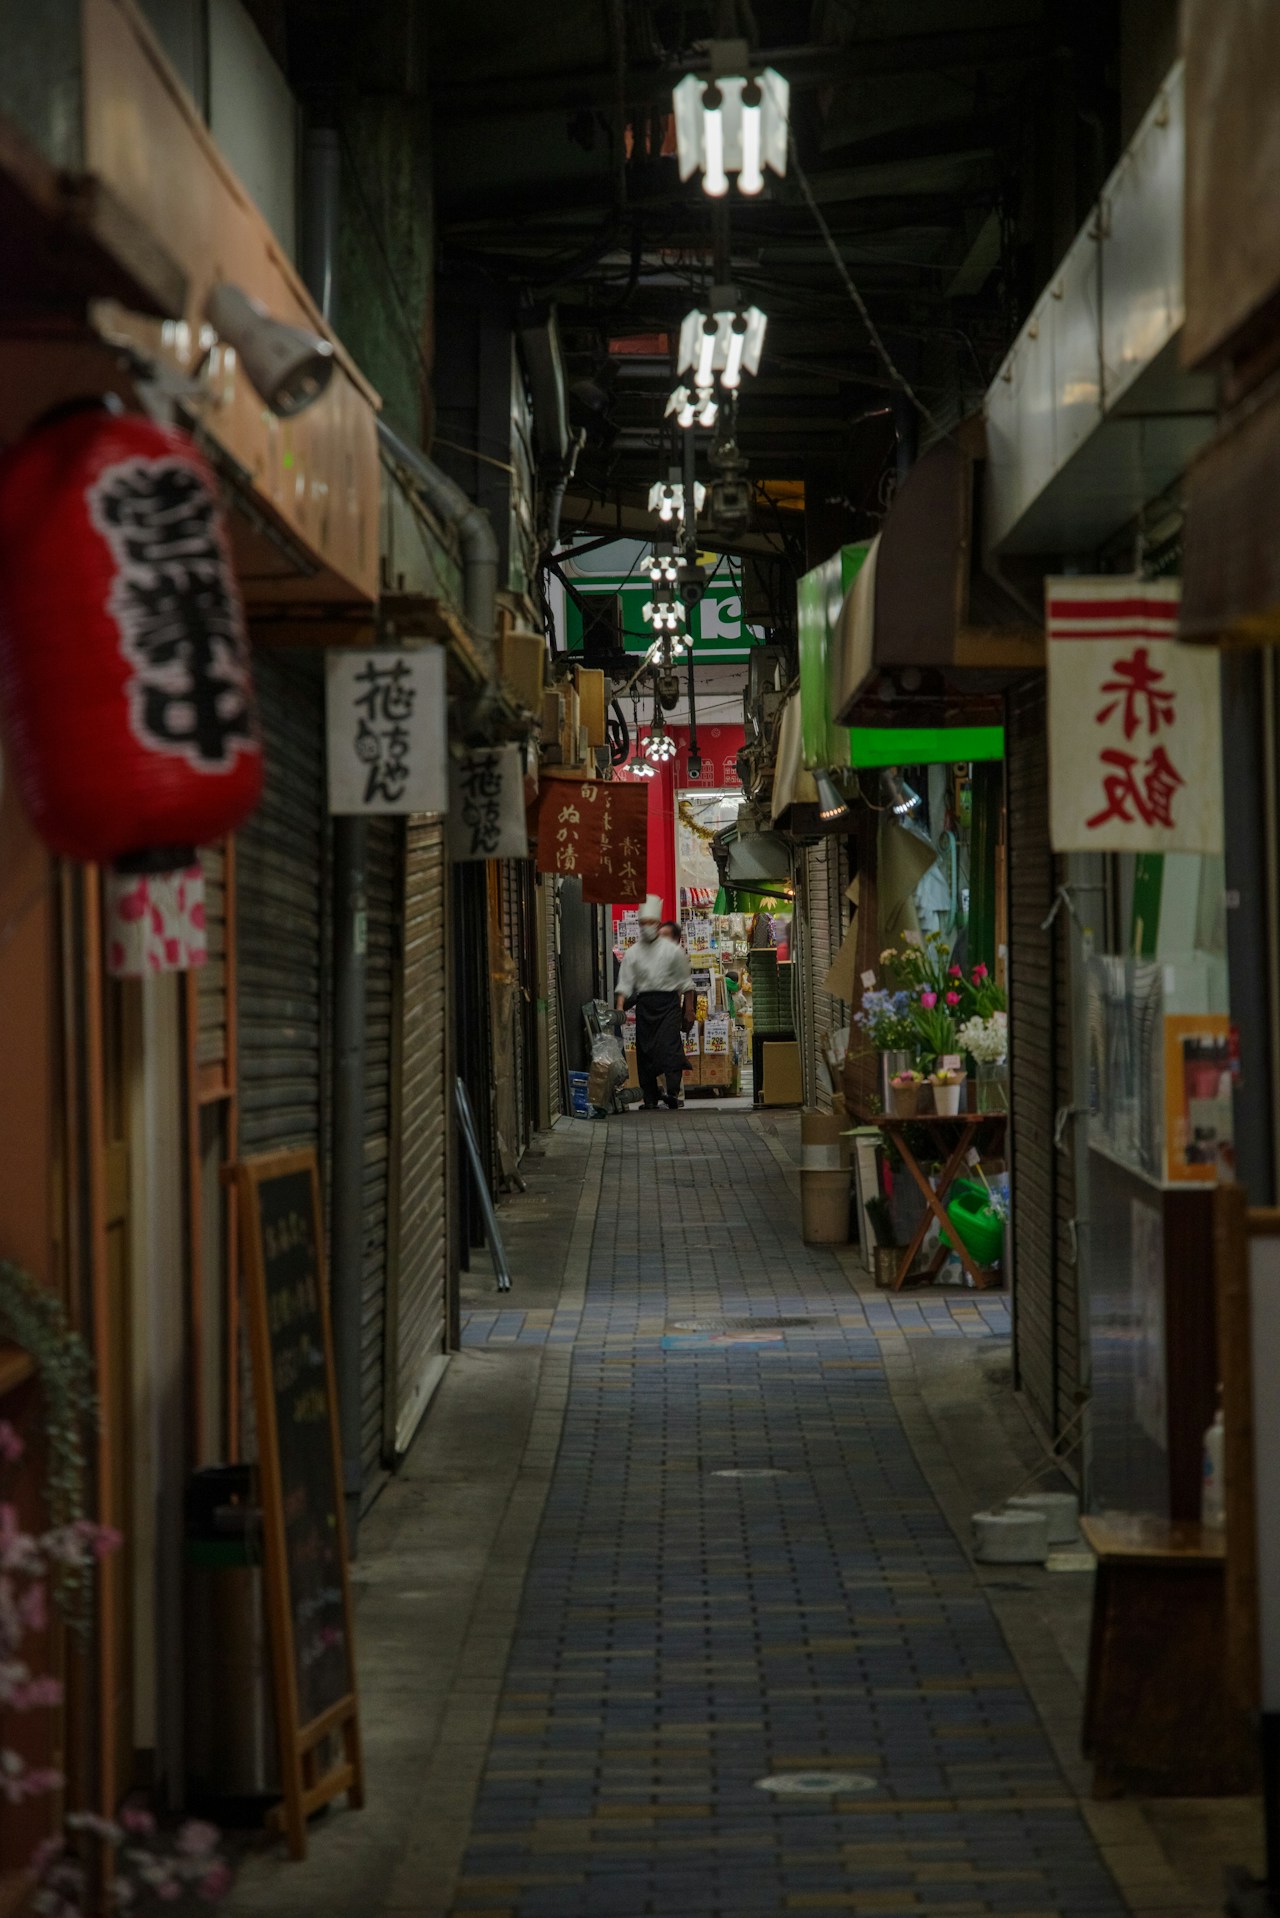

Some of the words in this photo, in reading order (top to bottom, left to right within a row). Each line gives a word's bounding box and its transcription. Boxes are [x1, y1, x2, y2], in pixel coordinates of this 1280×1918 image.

[101, 466, 248, 759] 営業中
[354, 657, 415, 804] 花ちゃん
[460, 754, 503, 855] 花ちゃん
[556, 804, 580, 871] ぬか漬
[581, 783, 598, 803] 旬
